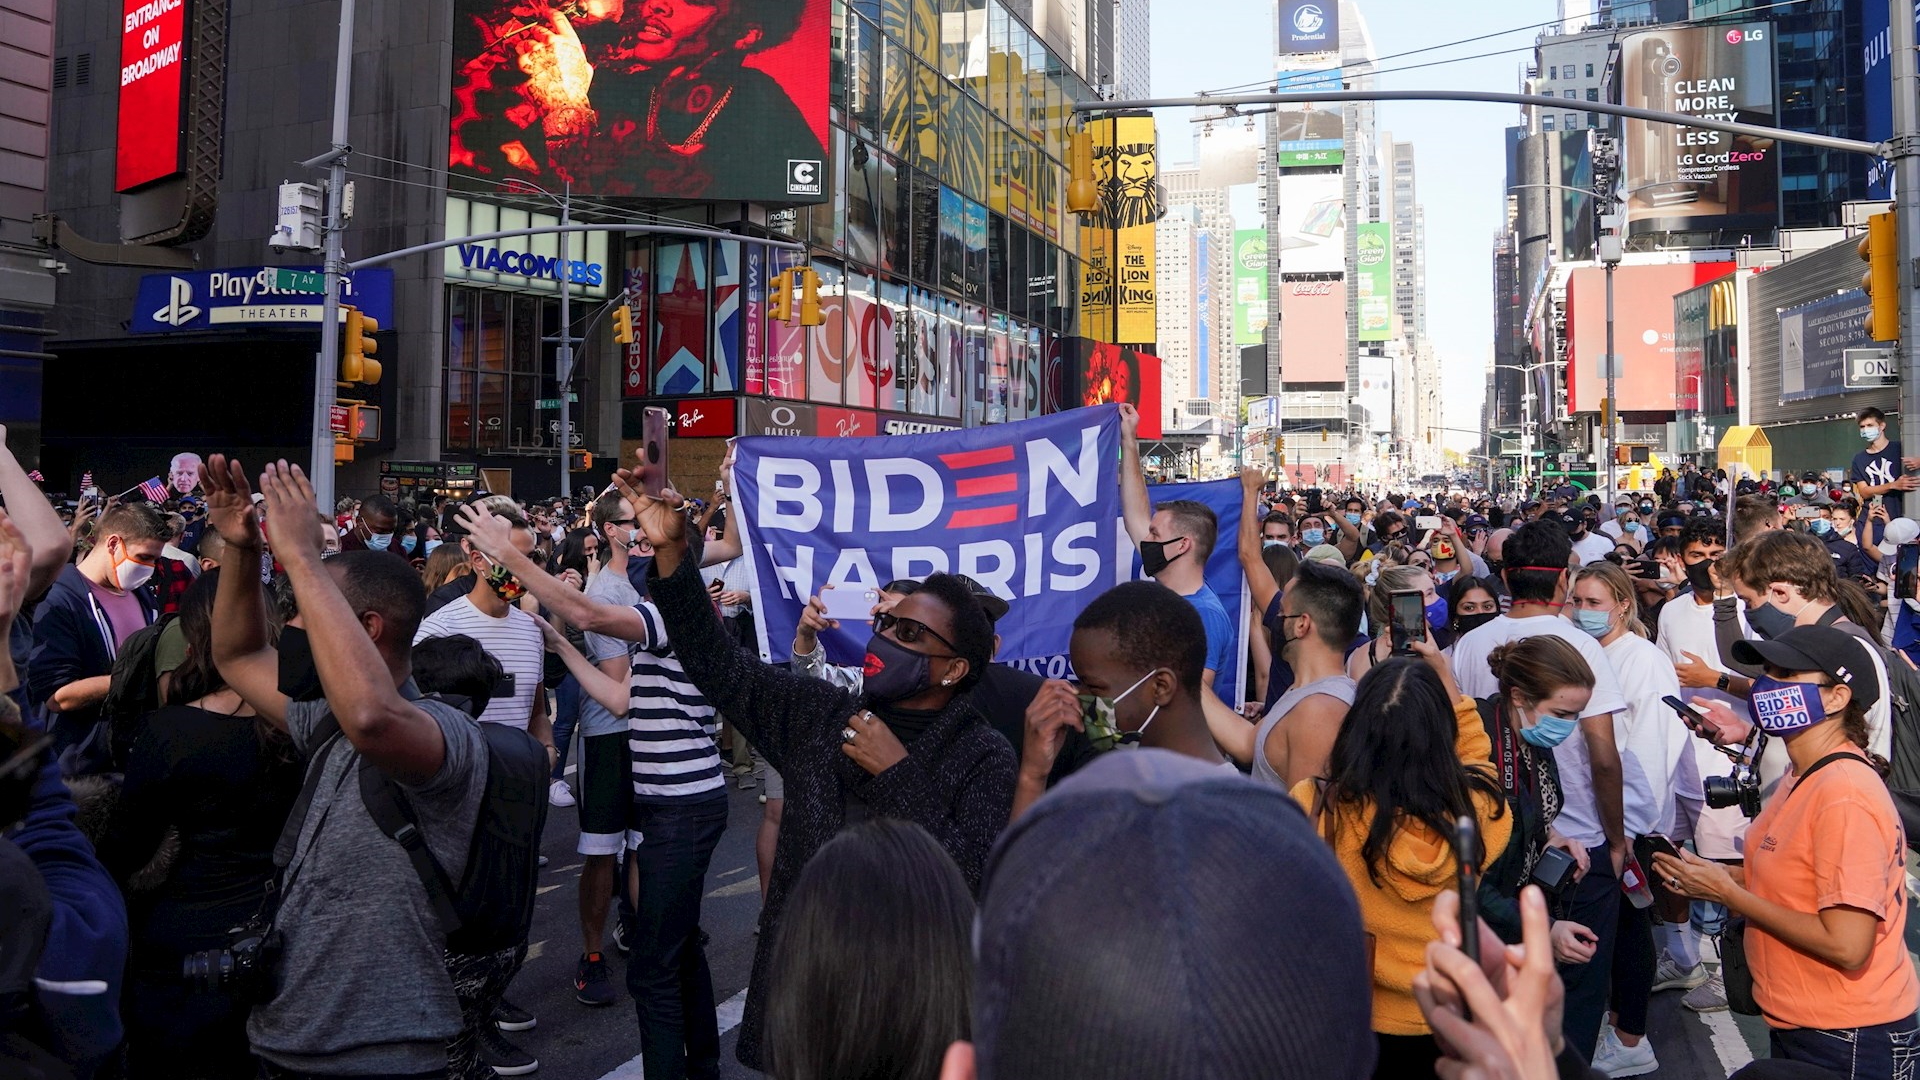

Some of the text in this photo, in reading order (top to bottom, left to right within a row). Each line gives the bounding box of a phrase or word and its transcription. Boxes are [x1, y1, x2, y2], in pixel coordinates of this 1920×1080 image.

[125, 0, 181, 33] ENTRANCE
[143, 25, 160, 49] ON
[1291, 32, 1326, 41] Prudential
[1744, 29, 1763, 41] LG
[122, 41, 181, 87] BROADWAY
[1674, 77, 1735, 94] CLEAN
[1675, 96, 1735, 112] MORE,
[1676, 112, 1739, 129] PTY
[1676, 131, 1719, 146] LESS
[1677, 155, 1693, 166] LG
[1677, 164, 1740, 174] Kompressor Cordless
[1677, 173, 1693, 181] Stick
[790, 183, 819, 192] CINEMATIC
[1357, 247, 1384, 256] Green
[1359, 254, 1384, 263] Giant
[457, 243, 603, 286] VIACOMCBS
[1124, 255, 1145, 265] THE
[1246, 260, 1268, 268] Gian
[290, 273, 314, 287] 7 Av
[1121, 267, 1149, 284] LION
[748, 253, 758, 318] NEWS
[1119, 285, 1154, 304] KING
[240, 308, 308, 318] THEATER
[1818, 321, 1847, 335] GROUND:
[1819, 334, 1847, 347] SECOND:
[629, 329, 641, 370] CBS
[764, 426, 801, 436] OAKLEY
[757, 424, 1101, 533] BIDEN
[1755, 687, 1800, 701] RIDIN WITH
[1757, 694, 1804, 713] BIDEN
[1762, 711, 1808, 729] 2020
[1504, 750, 1513, 764] 5D
[1504, 765, 1513, 789] EOS
